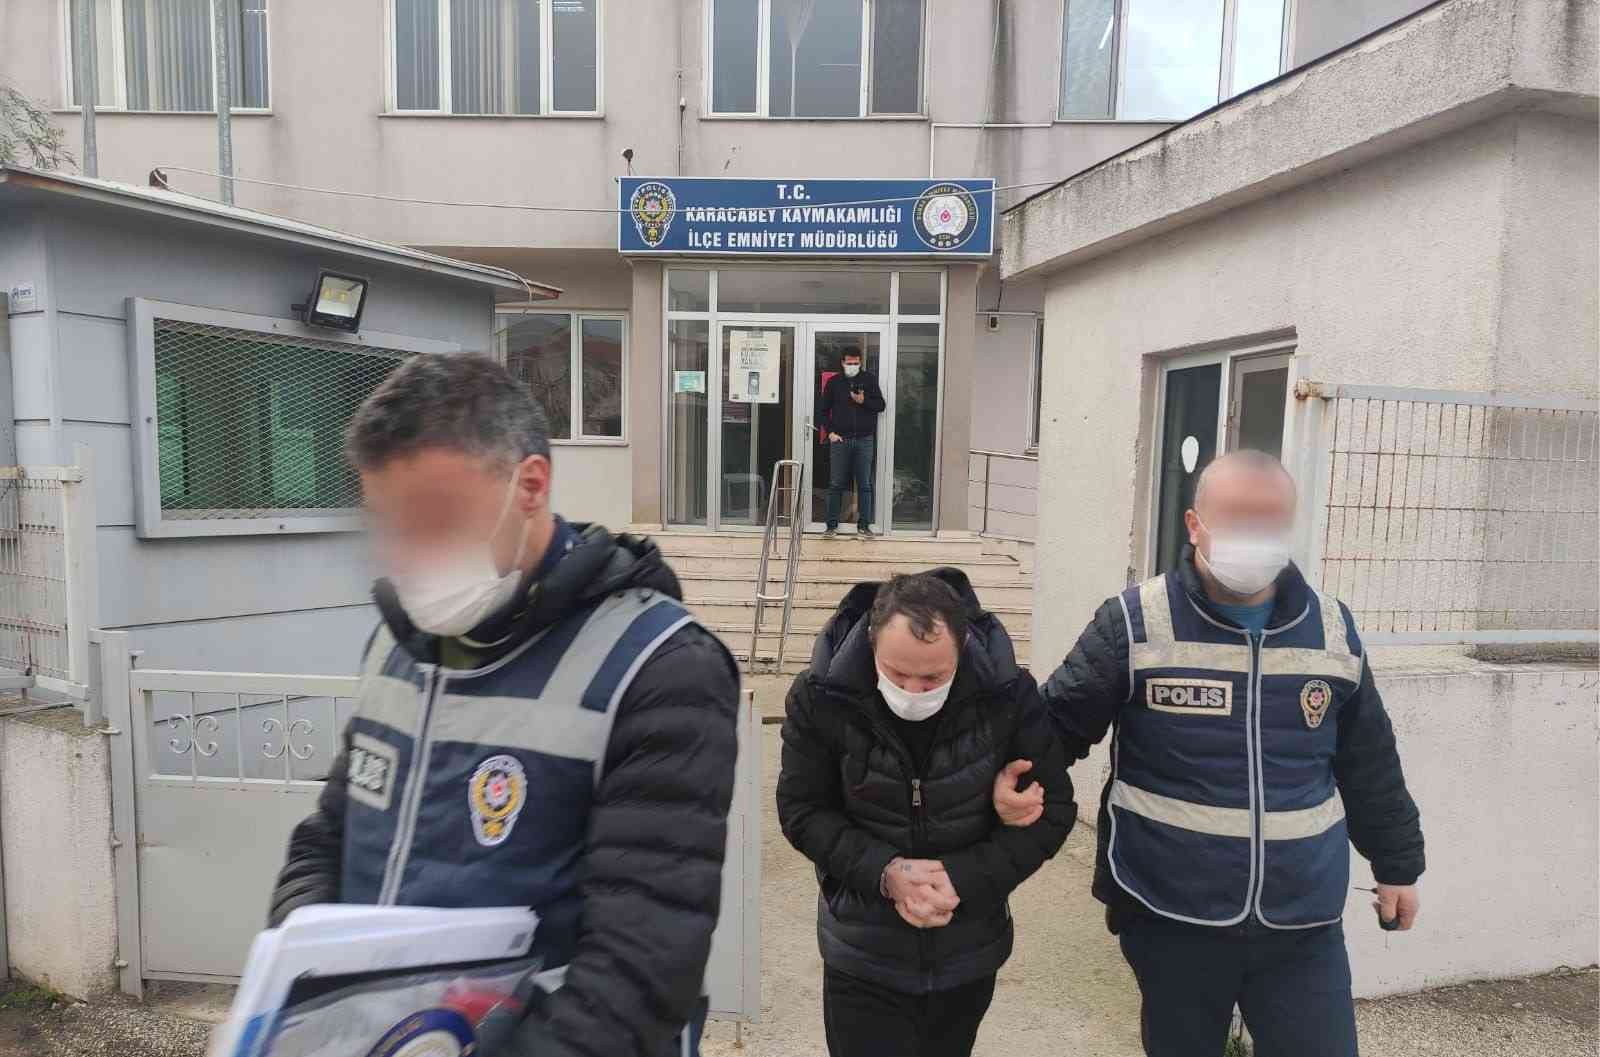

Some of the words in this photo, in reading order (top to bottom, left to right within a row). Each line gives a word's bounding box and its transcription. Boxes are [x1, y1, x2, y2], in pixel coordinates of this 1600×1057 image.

[776, 184, 811, 199] T.C.
[686, 206, 777, 222] KARACABEY
[782, 205, 902, 222] KAYMAKAMLIĞI
[688, 228, 722, 248] İLÇE
[727, 229, 795, 248] EMNİYET
[801, 229, 898, 248] MÜDÜRLÜĞÜ
